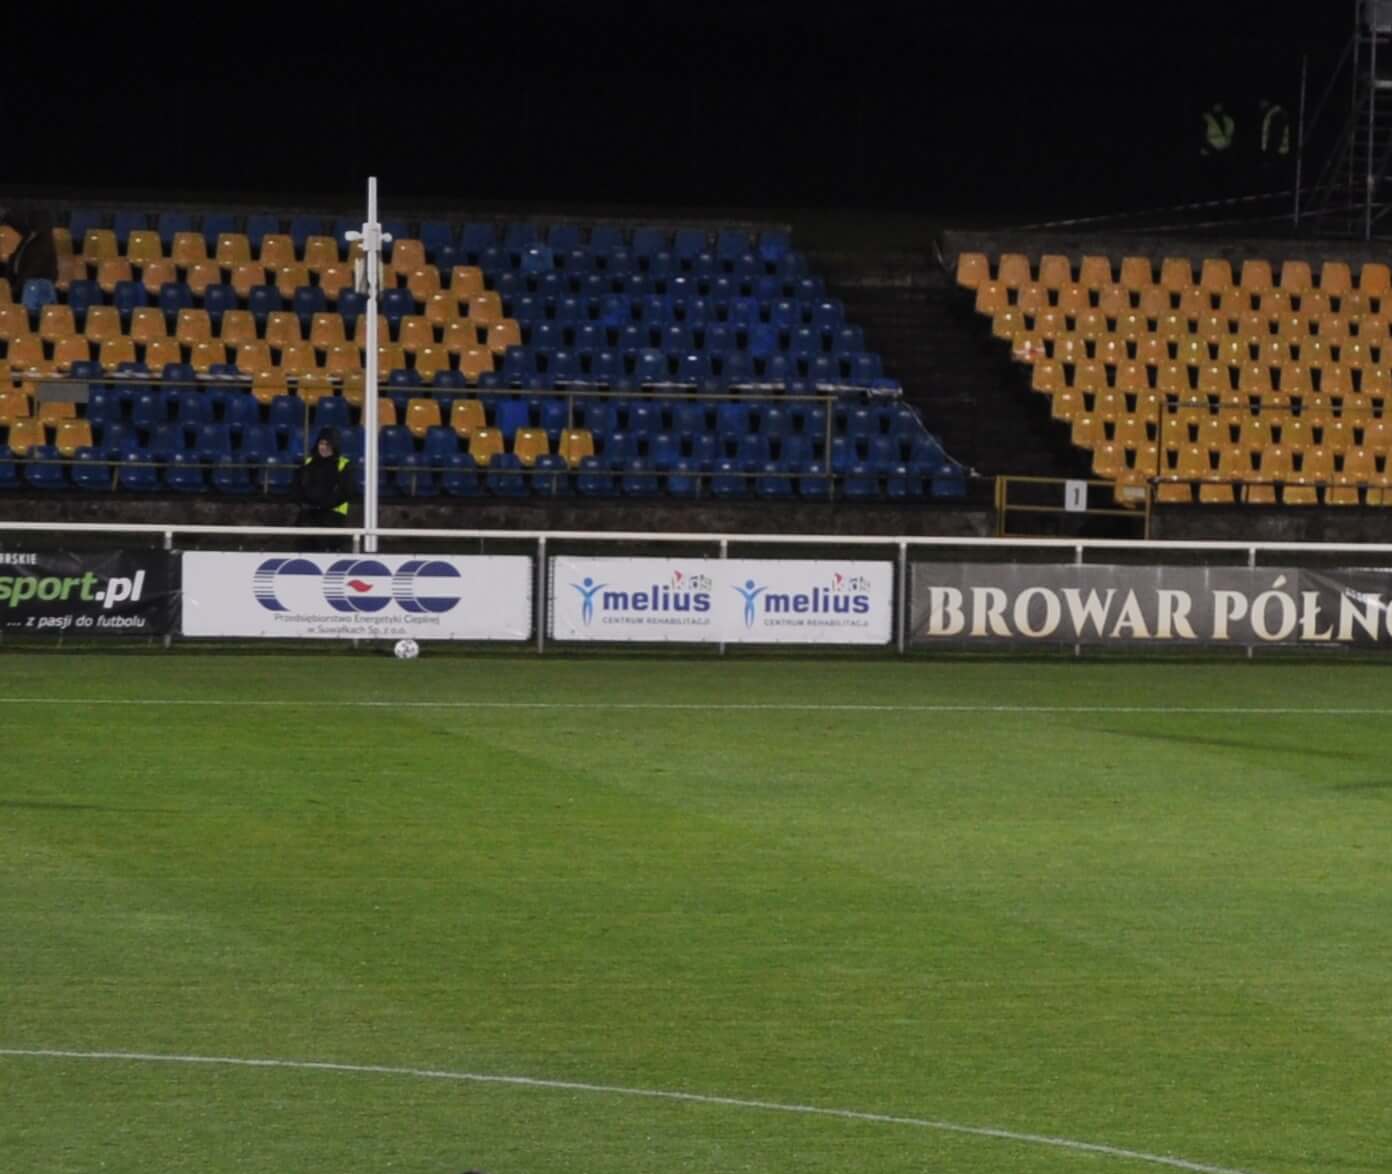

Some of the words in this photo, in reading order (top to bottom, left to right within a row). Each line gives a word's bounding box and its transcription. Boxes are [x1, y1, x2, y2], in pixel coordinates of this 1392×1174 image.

[603, 584, 711, 612] melius
[764, 586, 870, 614] melius
[25, 616, 35, 627] z
[37, 615, 73, 629] pasji
[75, 614, 94, 627] do
[96, 615, 146, 628] futbolu
[927, 586, 1198, 642] BROWAR
